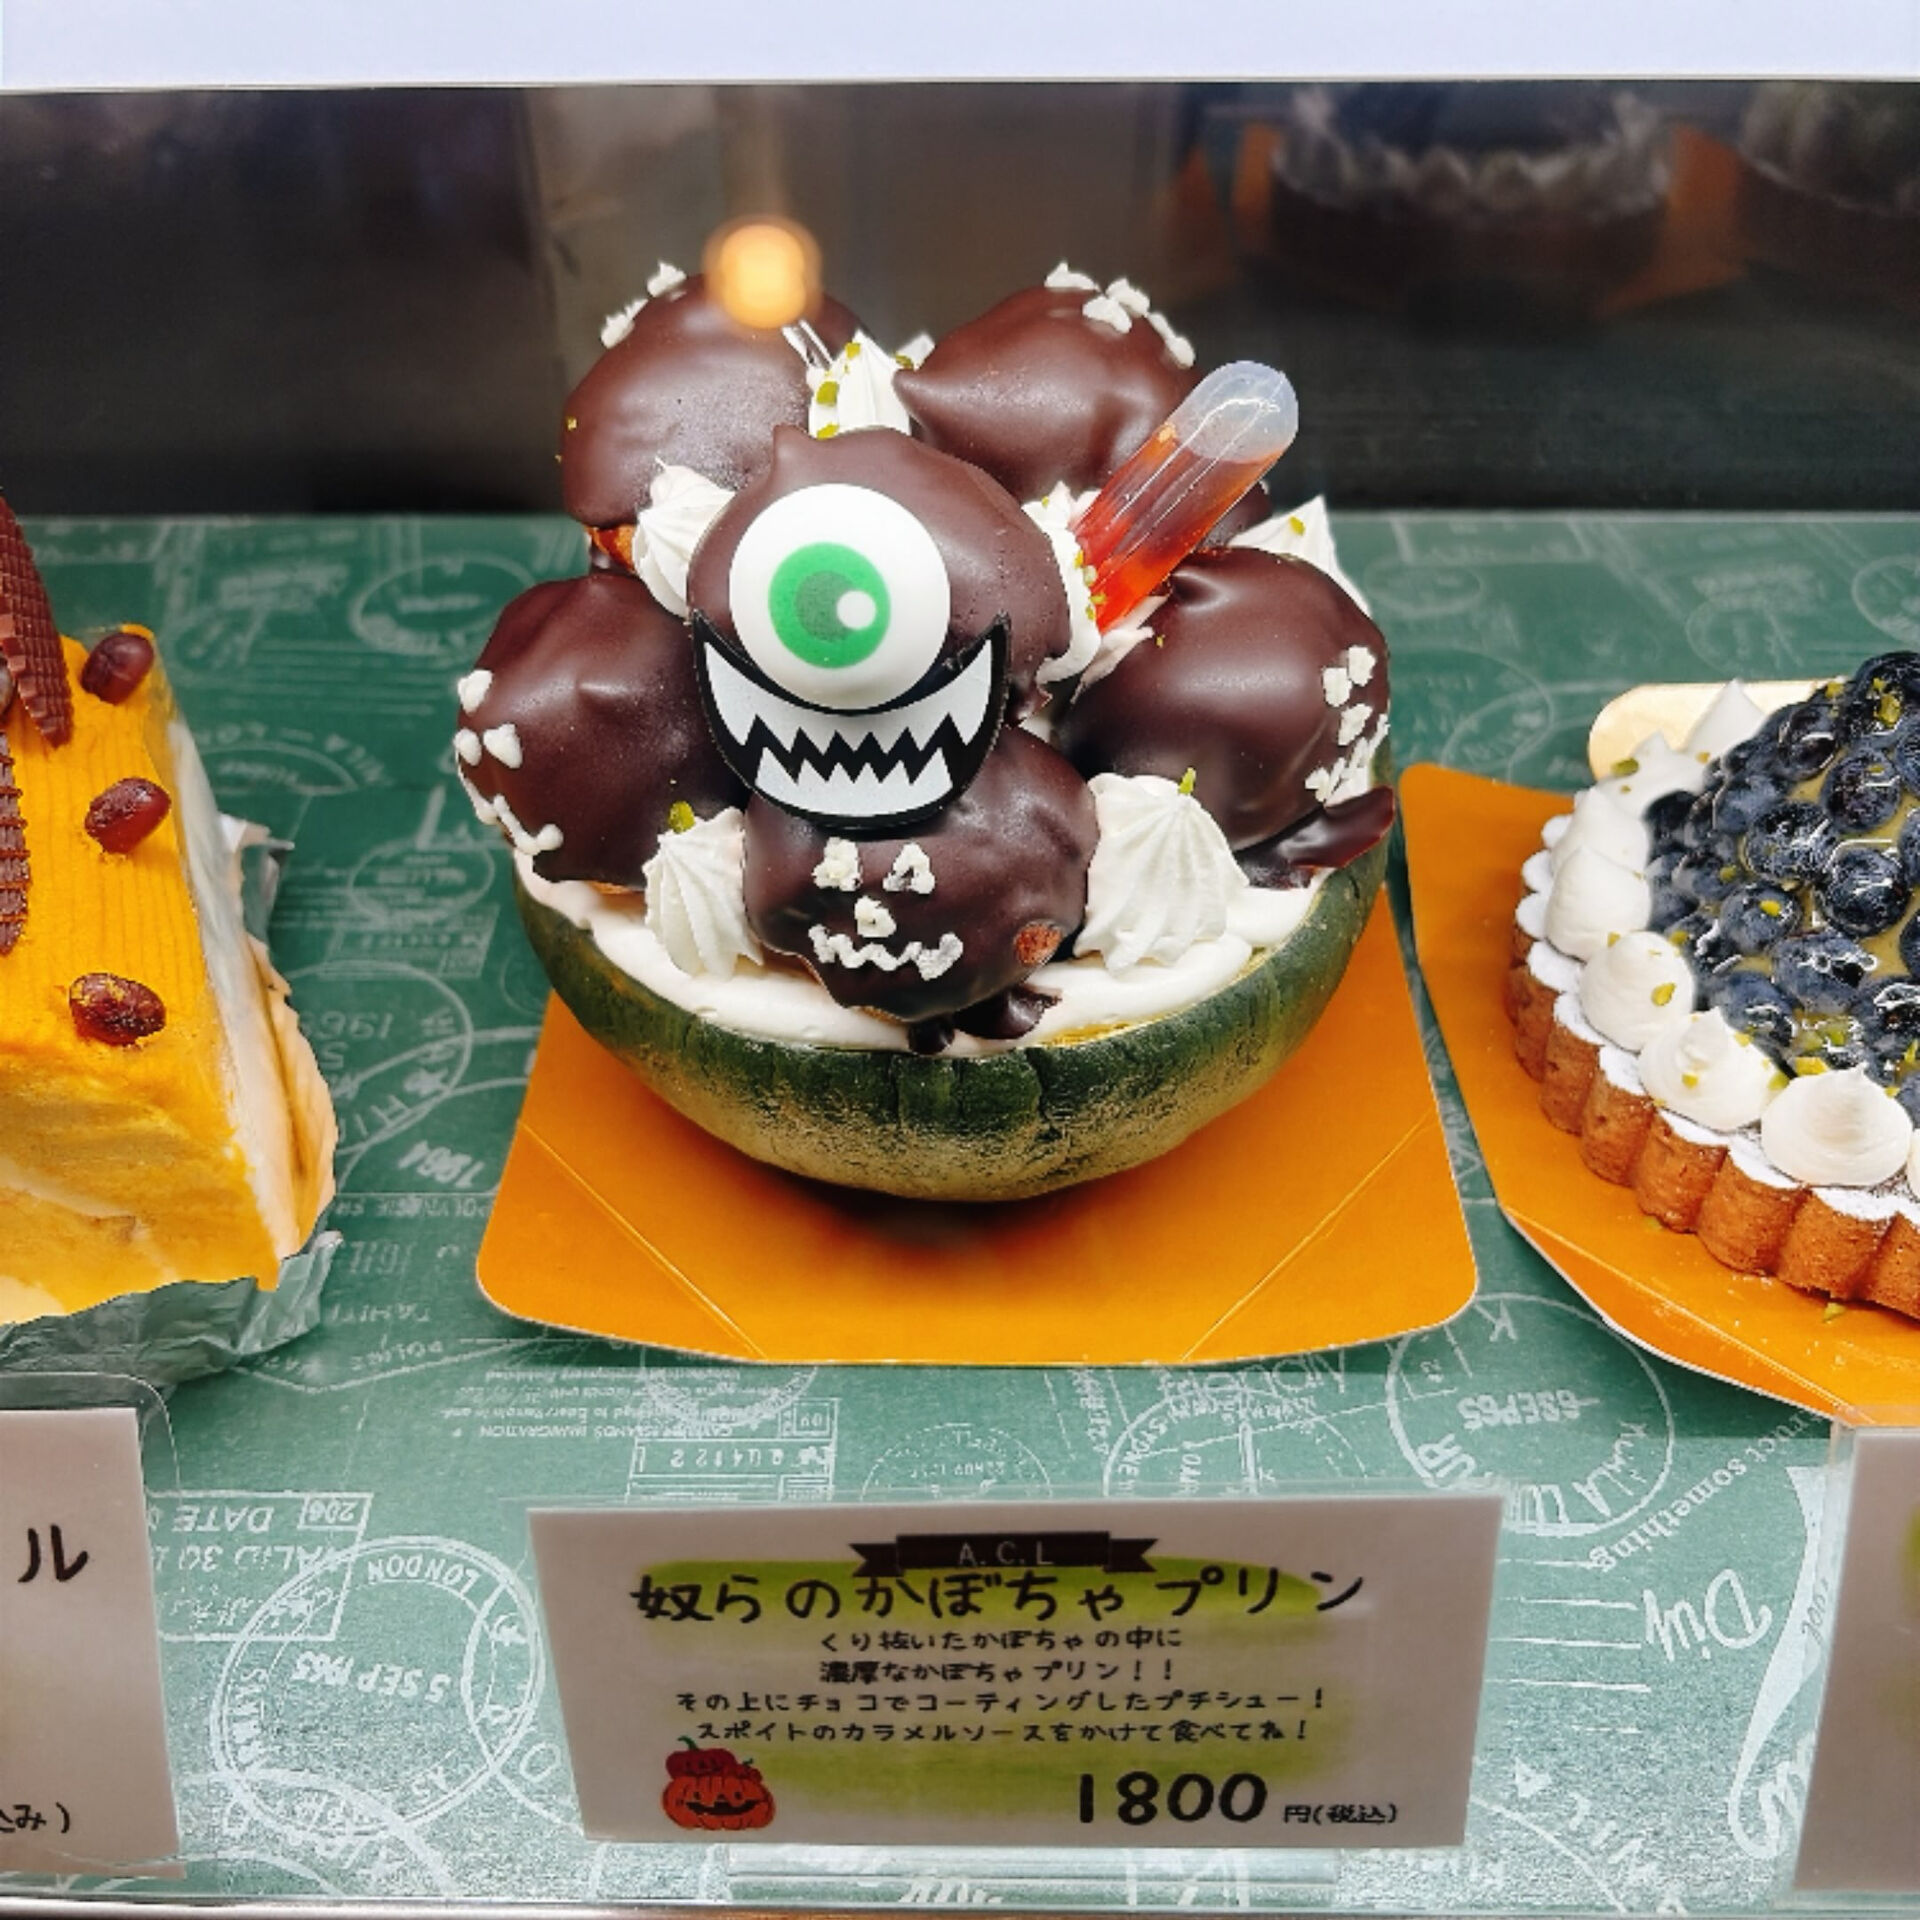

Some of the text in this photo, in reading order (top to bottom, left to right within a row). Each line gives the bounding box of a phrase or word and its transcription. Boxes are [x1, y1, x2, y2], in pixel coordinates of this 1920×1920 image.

[173, 1504, 275, 1532] DATE
[1586, 1457, 1747, 1574] something
[18, 1524, 89, 1583] ル
[366, 1552, 481, 1594] LONDON
[630, 1565, 1363, 1624] 奴らのかぼちゃプリン
[1641, 1568, 1773, 1662] Diy
[820, 1628, 1182, 1653] くり抜いたかぼちゃの中に
[356, 1662, 427, 1696] SEP
[1079, 1770, 1268, 1826] 1800
